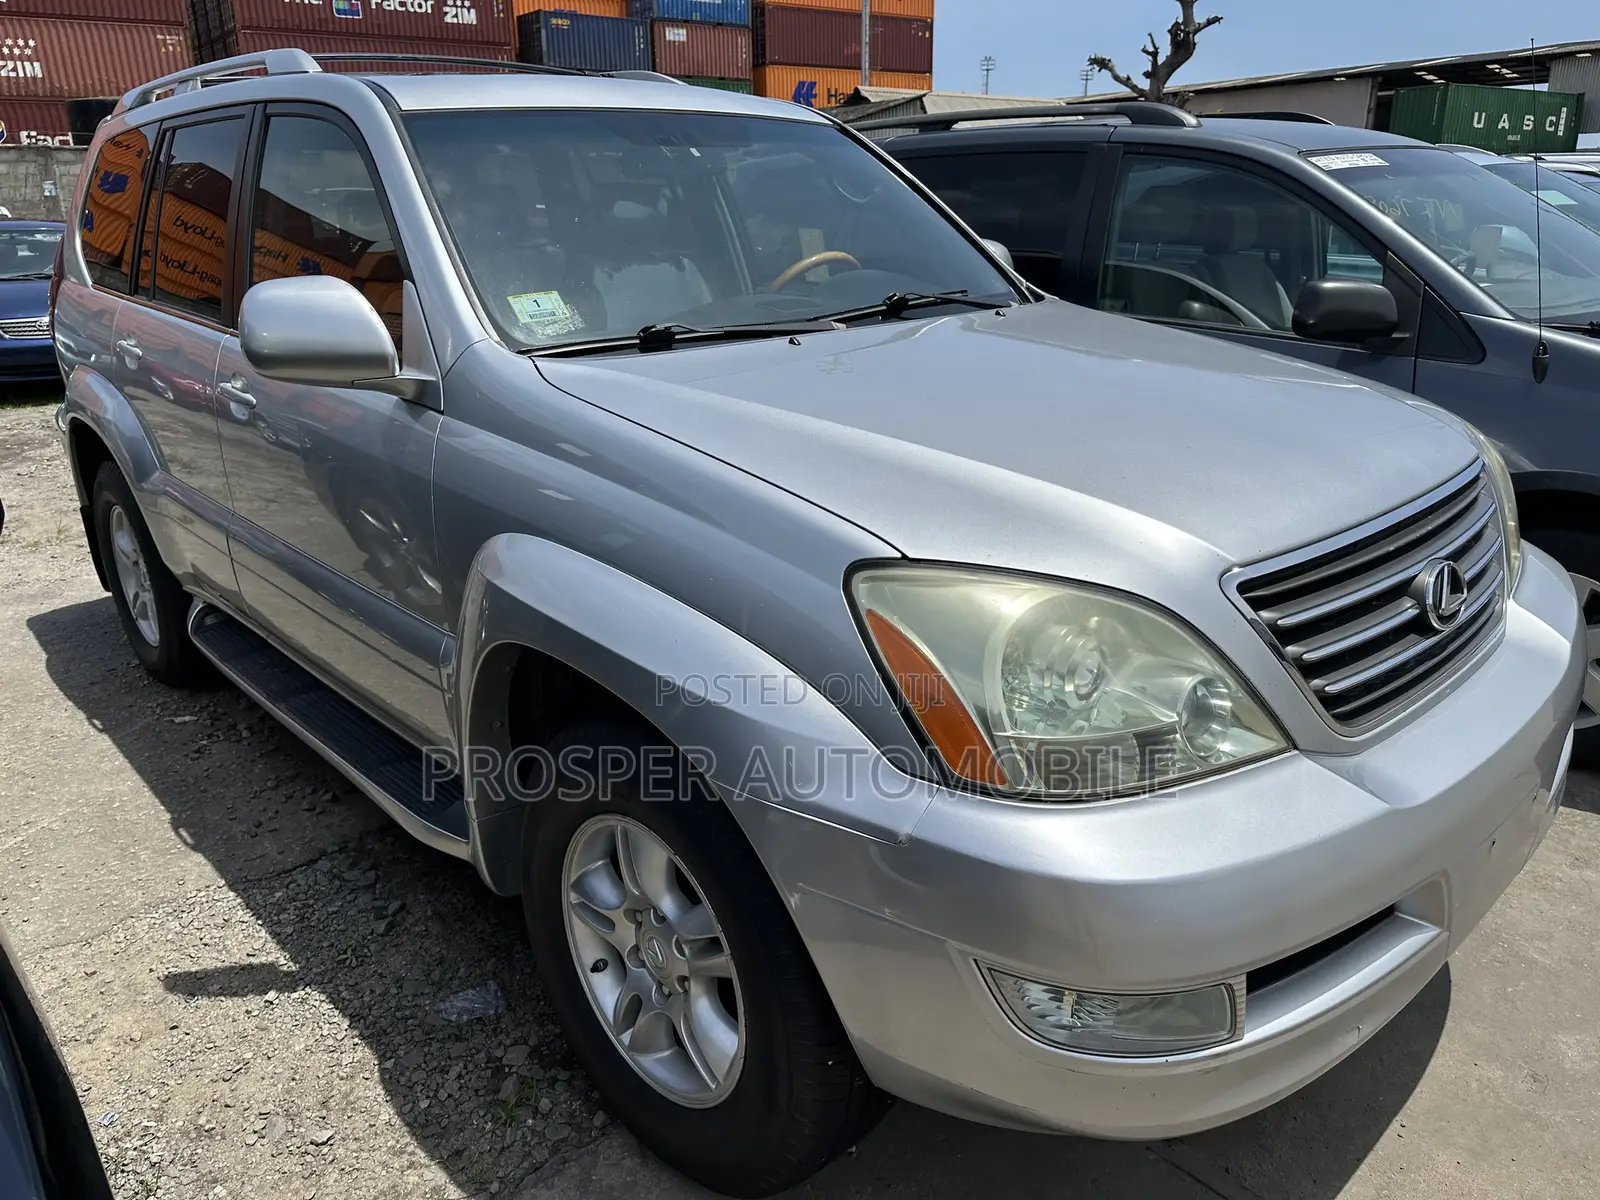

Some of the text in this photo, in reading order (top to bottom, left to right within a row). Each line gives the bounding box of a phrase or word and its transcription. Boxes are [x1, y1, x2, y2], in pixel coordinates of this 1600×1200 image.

[443, 6, 477, 25] ZIM
[0, 61, 43, 78] ZIM
[827, 88, 853, 105] Ha
[1473, 111, 1556, 132] UASC
[532, 299, 541, 308] 1
